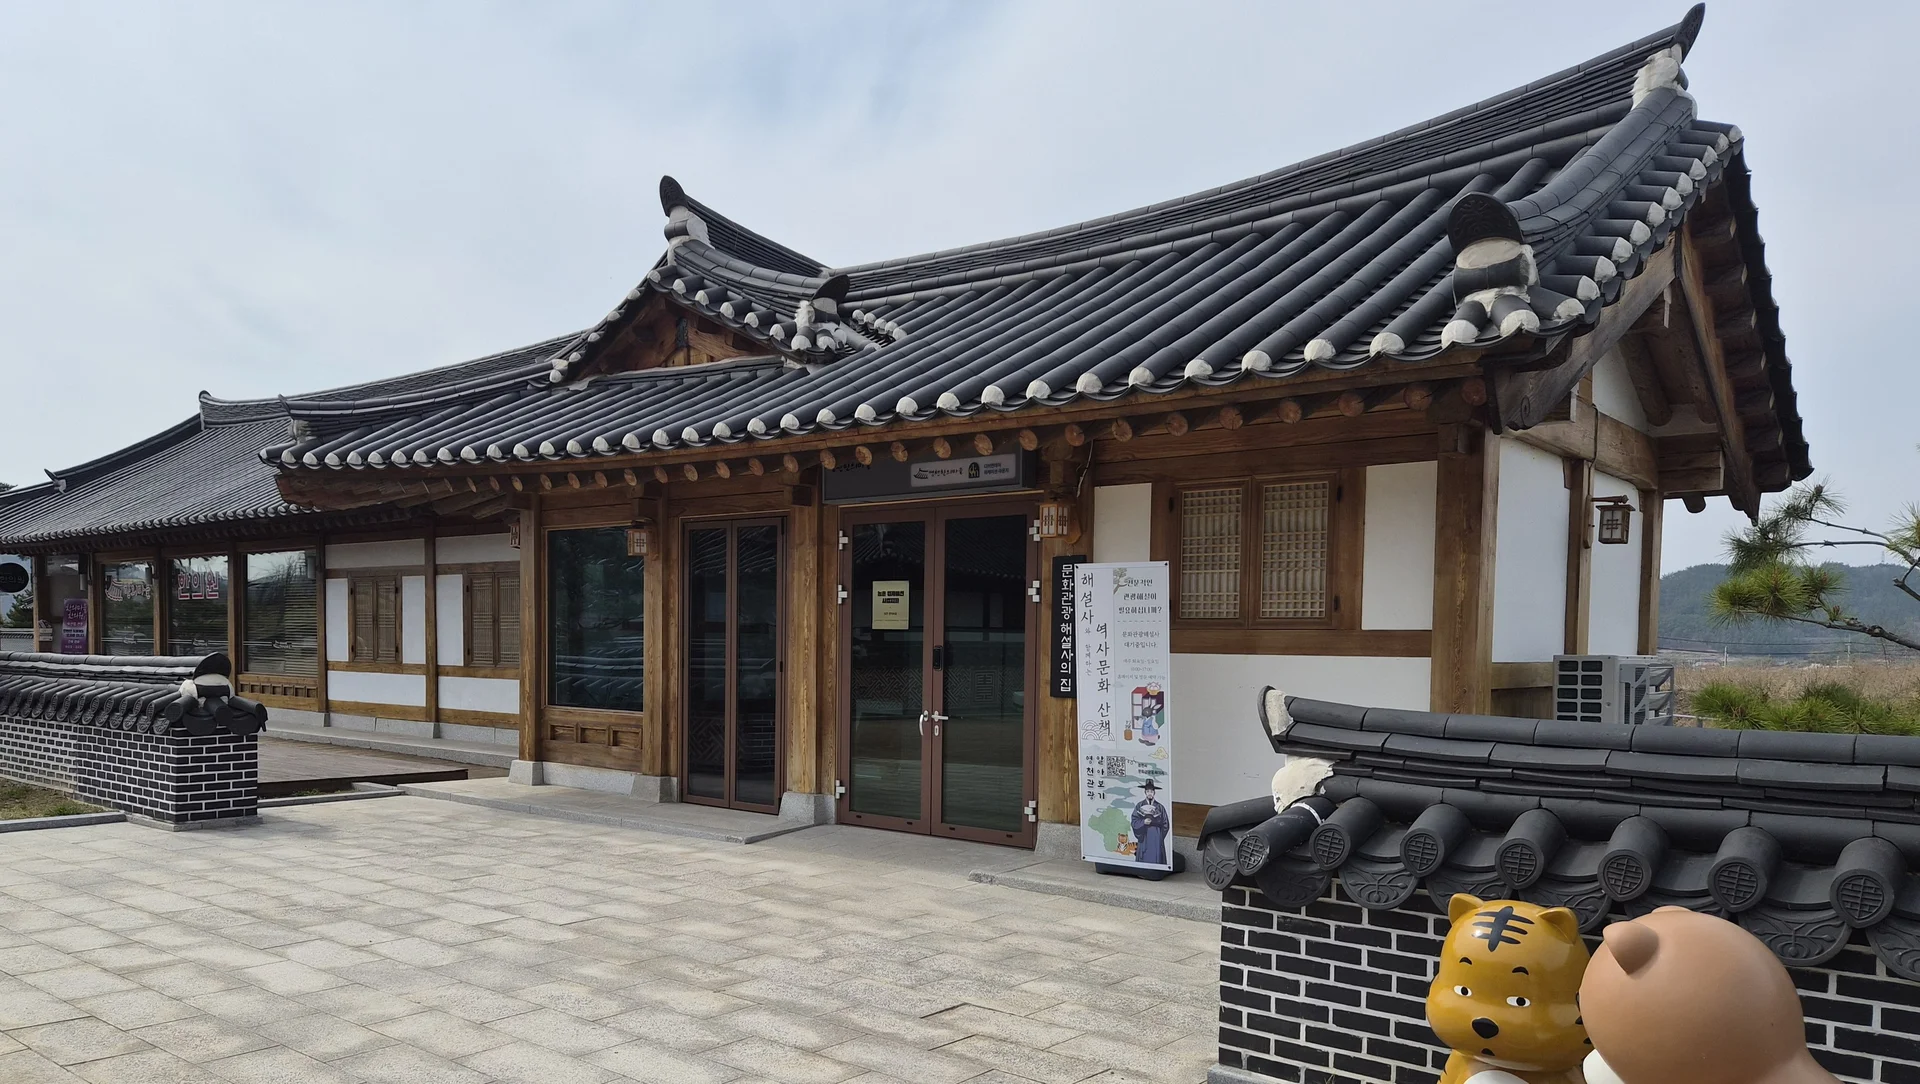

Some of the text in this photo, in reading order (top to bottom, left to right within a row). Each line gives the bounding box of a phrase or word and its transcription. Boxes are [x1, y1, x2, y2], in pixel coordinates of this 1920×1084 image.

[178, 571, 219, 600] 한의원
[1060, 564, 1074, 692] 문화관광 해설사의 집
[1096, 623, 1111, 736] 역사문화 산책
